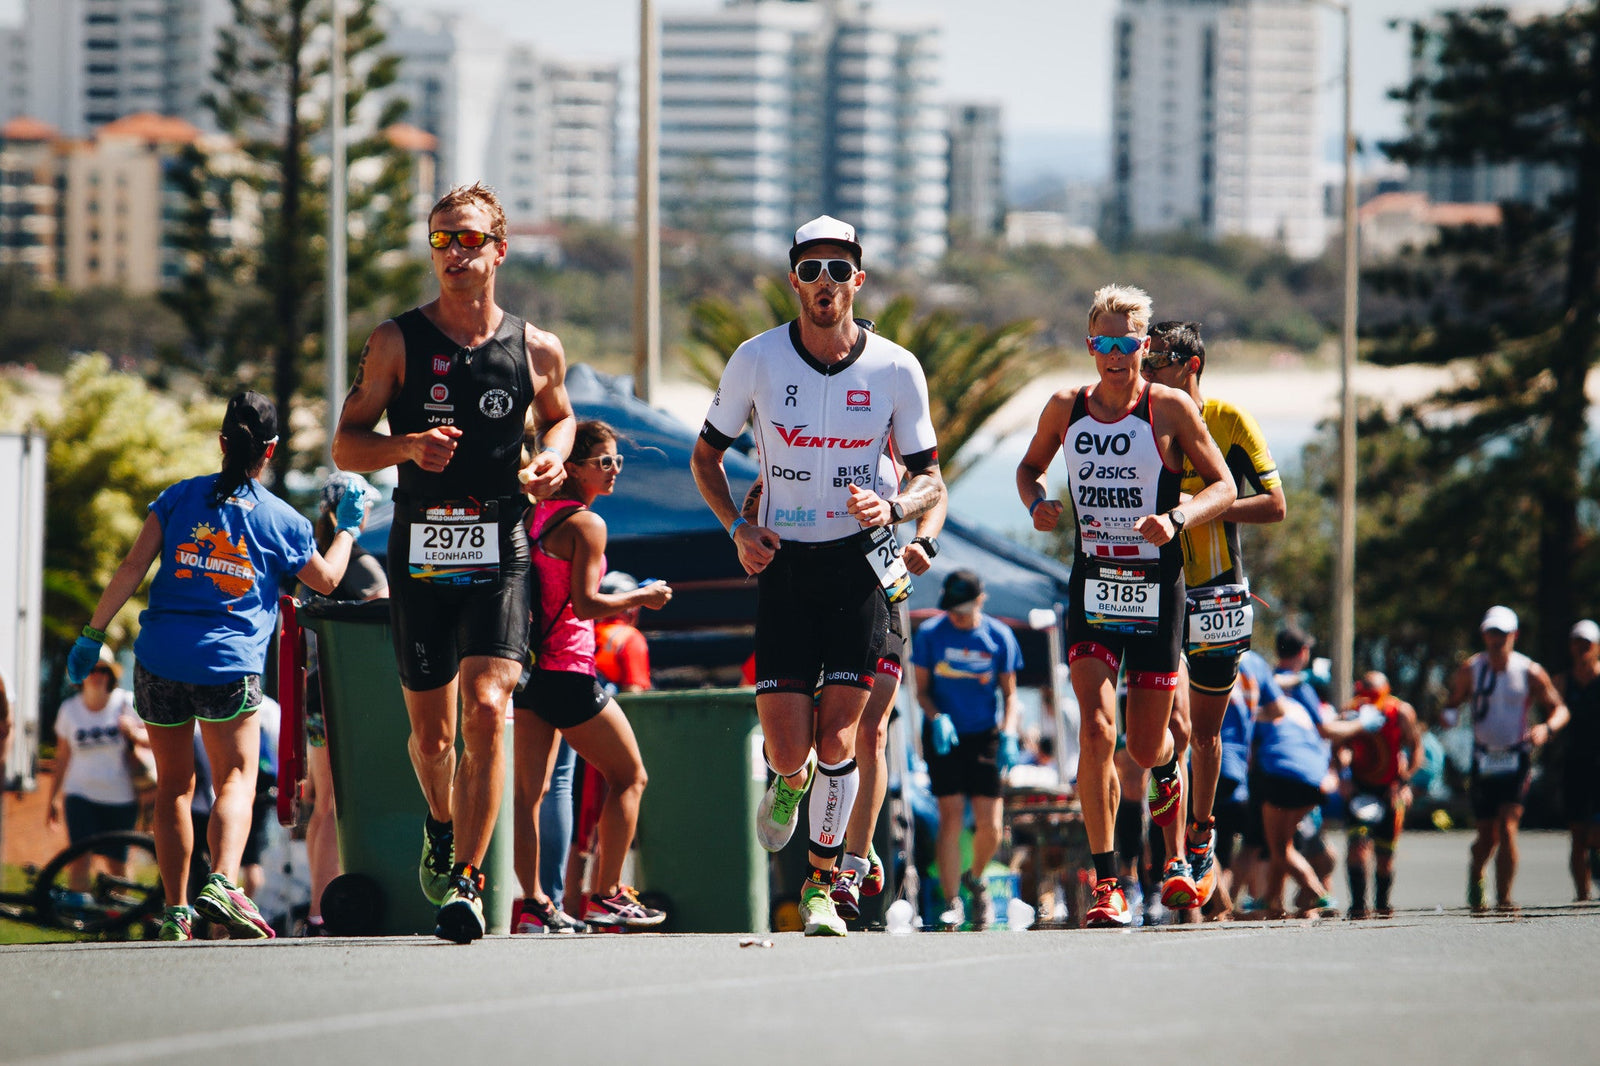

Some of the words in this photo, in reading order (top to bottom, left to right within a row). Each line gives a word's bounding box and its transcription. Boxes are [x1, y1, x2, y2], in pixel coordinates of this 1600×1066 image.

[433, 358, 450, 372] FIAT
[428, 416, 454, 425] Jeep
[775, 425, 874, 449] VENTUM
[838, 464, 870, 477] BIKE
[833, 474, 872, 488] BROS
[1079, 485, 1143, 508] 226ERS
[775, 508, 816, 521] PURE
[423, 526, 485, 549] 2978
[425, 551, 483, 560] LEONHARD
[180, 551, 255, 579] VOLUNTEER
[1096, 582, 1147, 603] 3185
[1098, 602, 1144, 613] BENJAMIN
[1200, 610, 1244, 631] 3012
[1204, 629, 1242, 640] OSVALDO
[823, 777, 839, 833] COMPRESPORT
[1152, 793, 1180, 817] BROOKS
